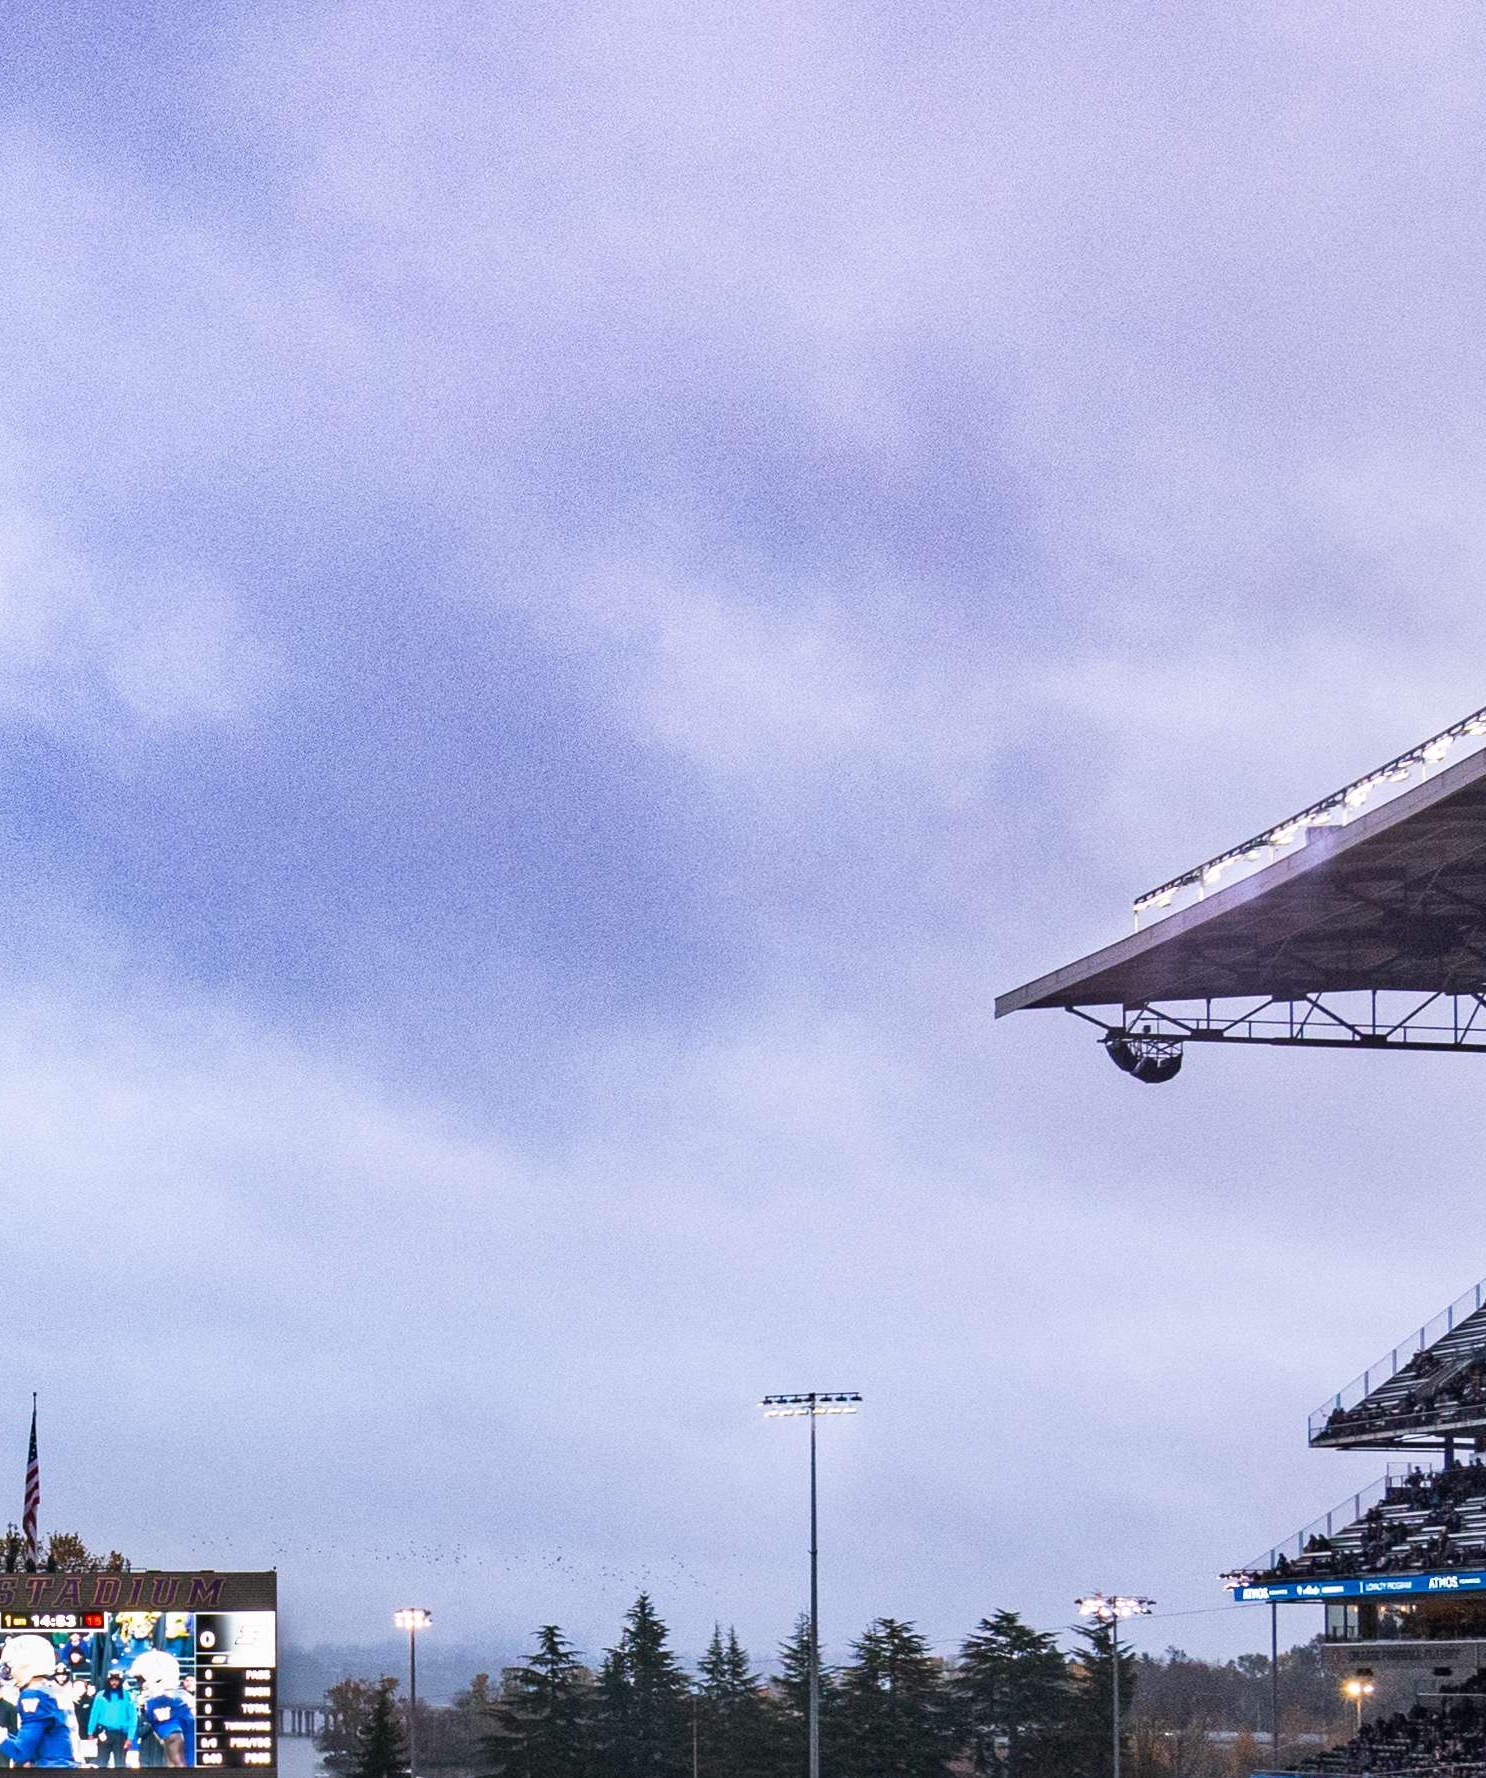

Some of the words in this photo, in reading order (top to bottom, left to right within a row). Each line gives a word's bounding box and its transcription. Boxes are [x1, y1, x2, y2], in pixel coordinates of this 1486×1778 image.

[31, 1614, 76, 1628] 14:53
[86, 1615, 103, 1627] 15
[199, 1630, 216, 1648] 0
